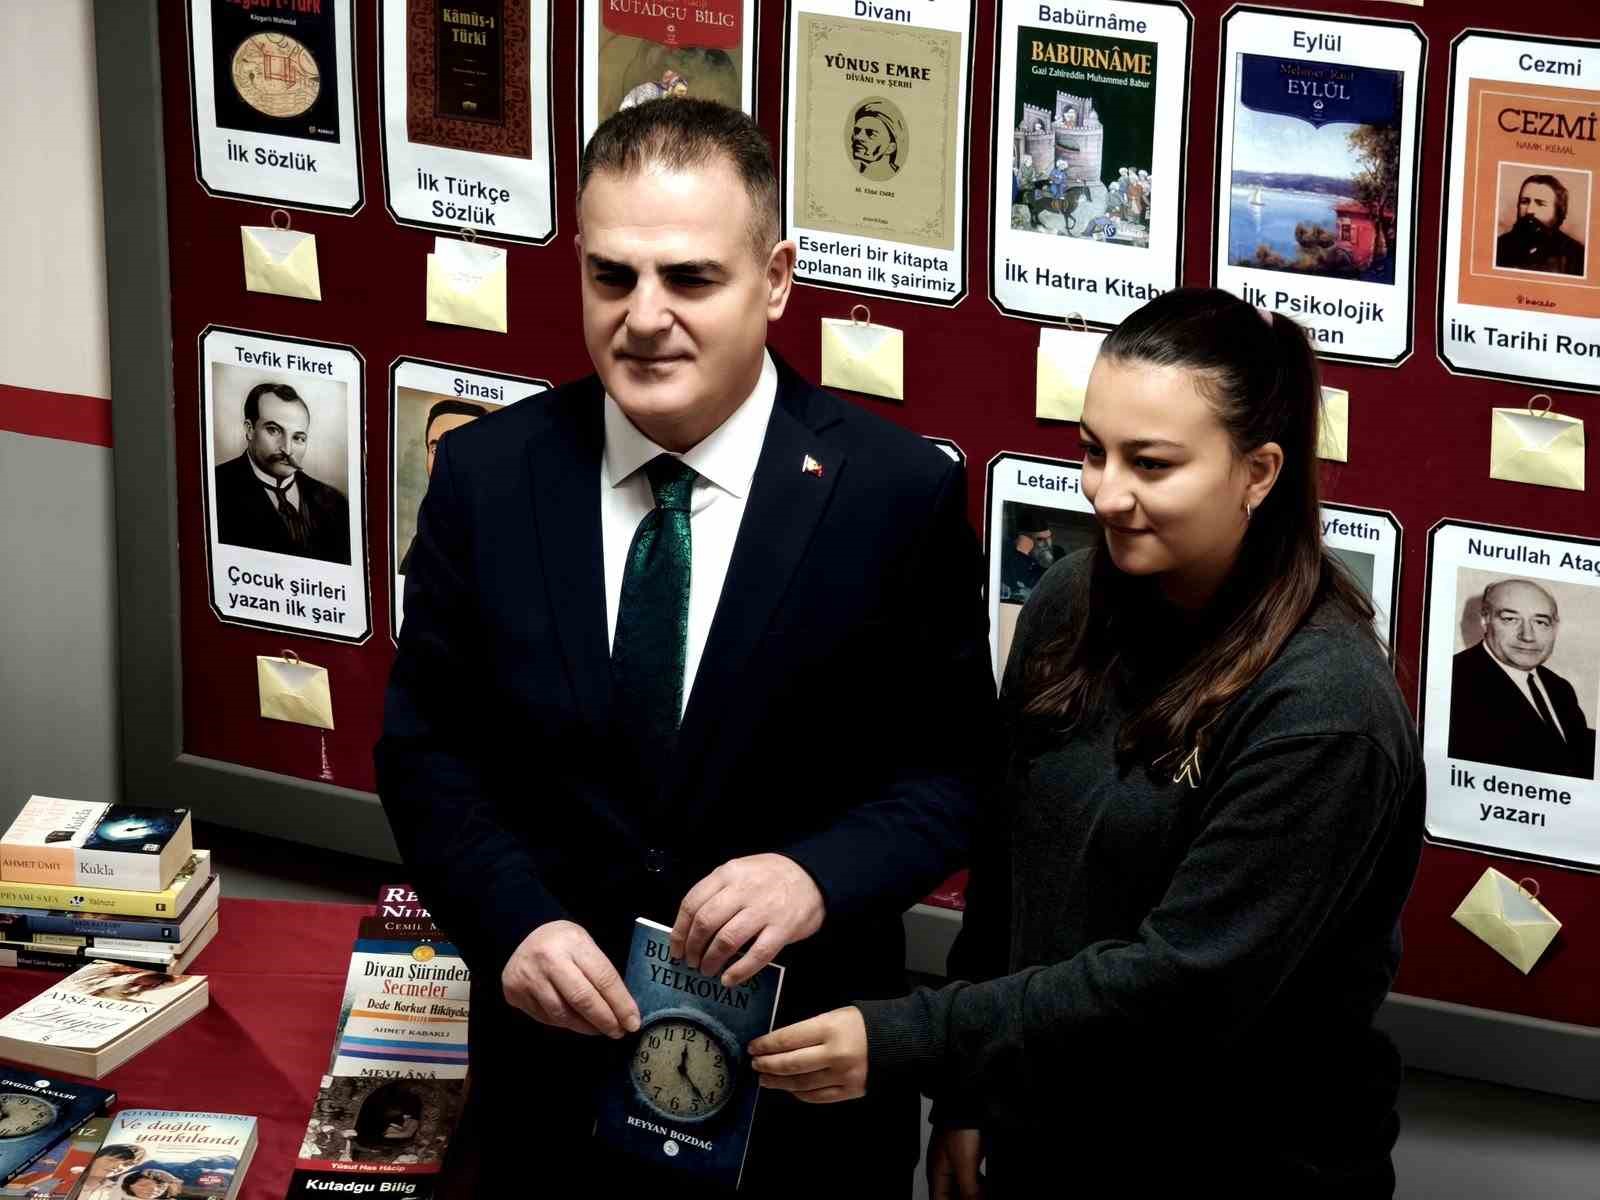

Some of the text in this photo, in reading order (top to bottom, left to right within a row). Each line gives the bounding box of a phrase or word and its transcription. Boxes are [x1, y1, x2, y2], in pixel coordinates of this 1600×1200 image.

[609, 0, 687, 20] KUTADGU
[854, 0, 911, 23] Divanı
[1038, 4, 1147, 34] Babürnâme
[1293, 30, 1342, 54] Eylül
[824, 53, 931, 81] YÛNUS EMRE
[1031, 40, 1152, 75] BABURNÂME
[1518, 53, 1582, 77] Cezmi
[1031, 65, 1048, 75] Gazi
[1086, 72, 1128, 87] Muhammed
[1287, 79, 1351, 100] EYLÜL
[1497, 107, 1598, 143] CEZMİ
[226, 139, 318, 173] İlk Sözlük
[417, 168, 511, 206] İlk Türkçe
[432, 200, 496, 226] Sözlük
[799, 235, 949, 273] Eserleri bir kitapta
[867, 266, 886, 284] ilk
[890, 273, 957, 295] şairimiz
[1004, 258, 1029, 284] İlk
[1035, 267, 1098, 293] Hatıra
[1242, 282, 1385, 325] İlk Psikolojik
[1450, 318, 1477, 345] İlk
[1483, 326, 1548, 353] Tarihi
[234, 346, 334, 377] Tevfik Fikret
[453, 377, 504, 402] Şinasi
[1017, 469, 1079, 494] Letaif-i
[1467, 537, 1552, 566] Nurullah
[227, 564, 347, 603] Çocuk şiirleri
[228, 591, 347, 625] yazan ilk şair
[1450, 764, 1573, 806] İlk deneme
[1479, 802, 1547, 828] yazarı
[79, 861, 115, 877] Kukla
[364, 960, 405, 980] Divan
[649, 963, 750, 1009] YELKOVAN
[367, 998, 391, 1010] Dede
[394, 1001, 427, 1014] Korkut
[373, 1027, 407, 1036] AHMET
[647, 1035, 661, 1050] 10
[664, 1028, 674, 1042] 11
[681, 1028, 696, 1043] 12
[640, 1050, 649, 1064] 9
[713, 1054, 722, 1069] 2
[642, 1069, 652, 1083] 8
[670, 1096, 680, 1111] 6
[120, 1119, 211, 1133] Ve dağlar
[627, 1115, 668, 1136] REYYAN
[136, 1131, 240, 1146] yankılandı
[305, 1178, 417, 1194] Kutadgu Bilig
